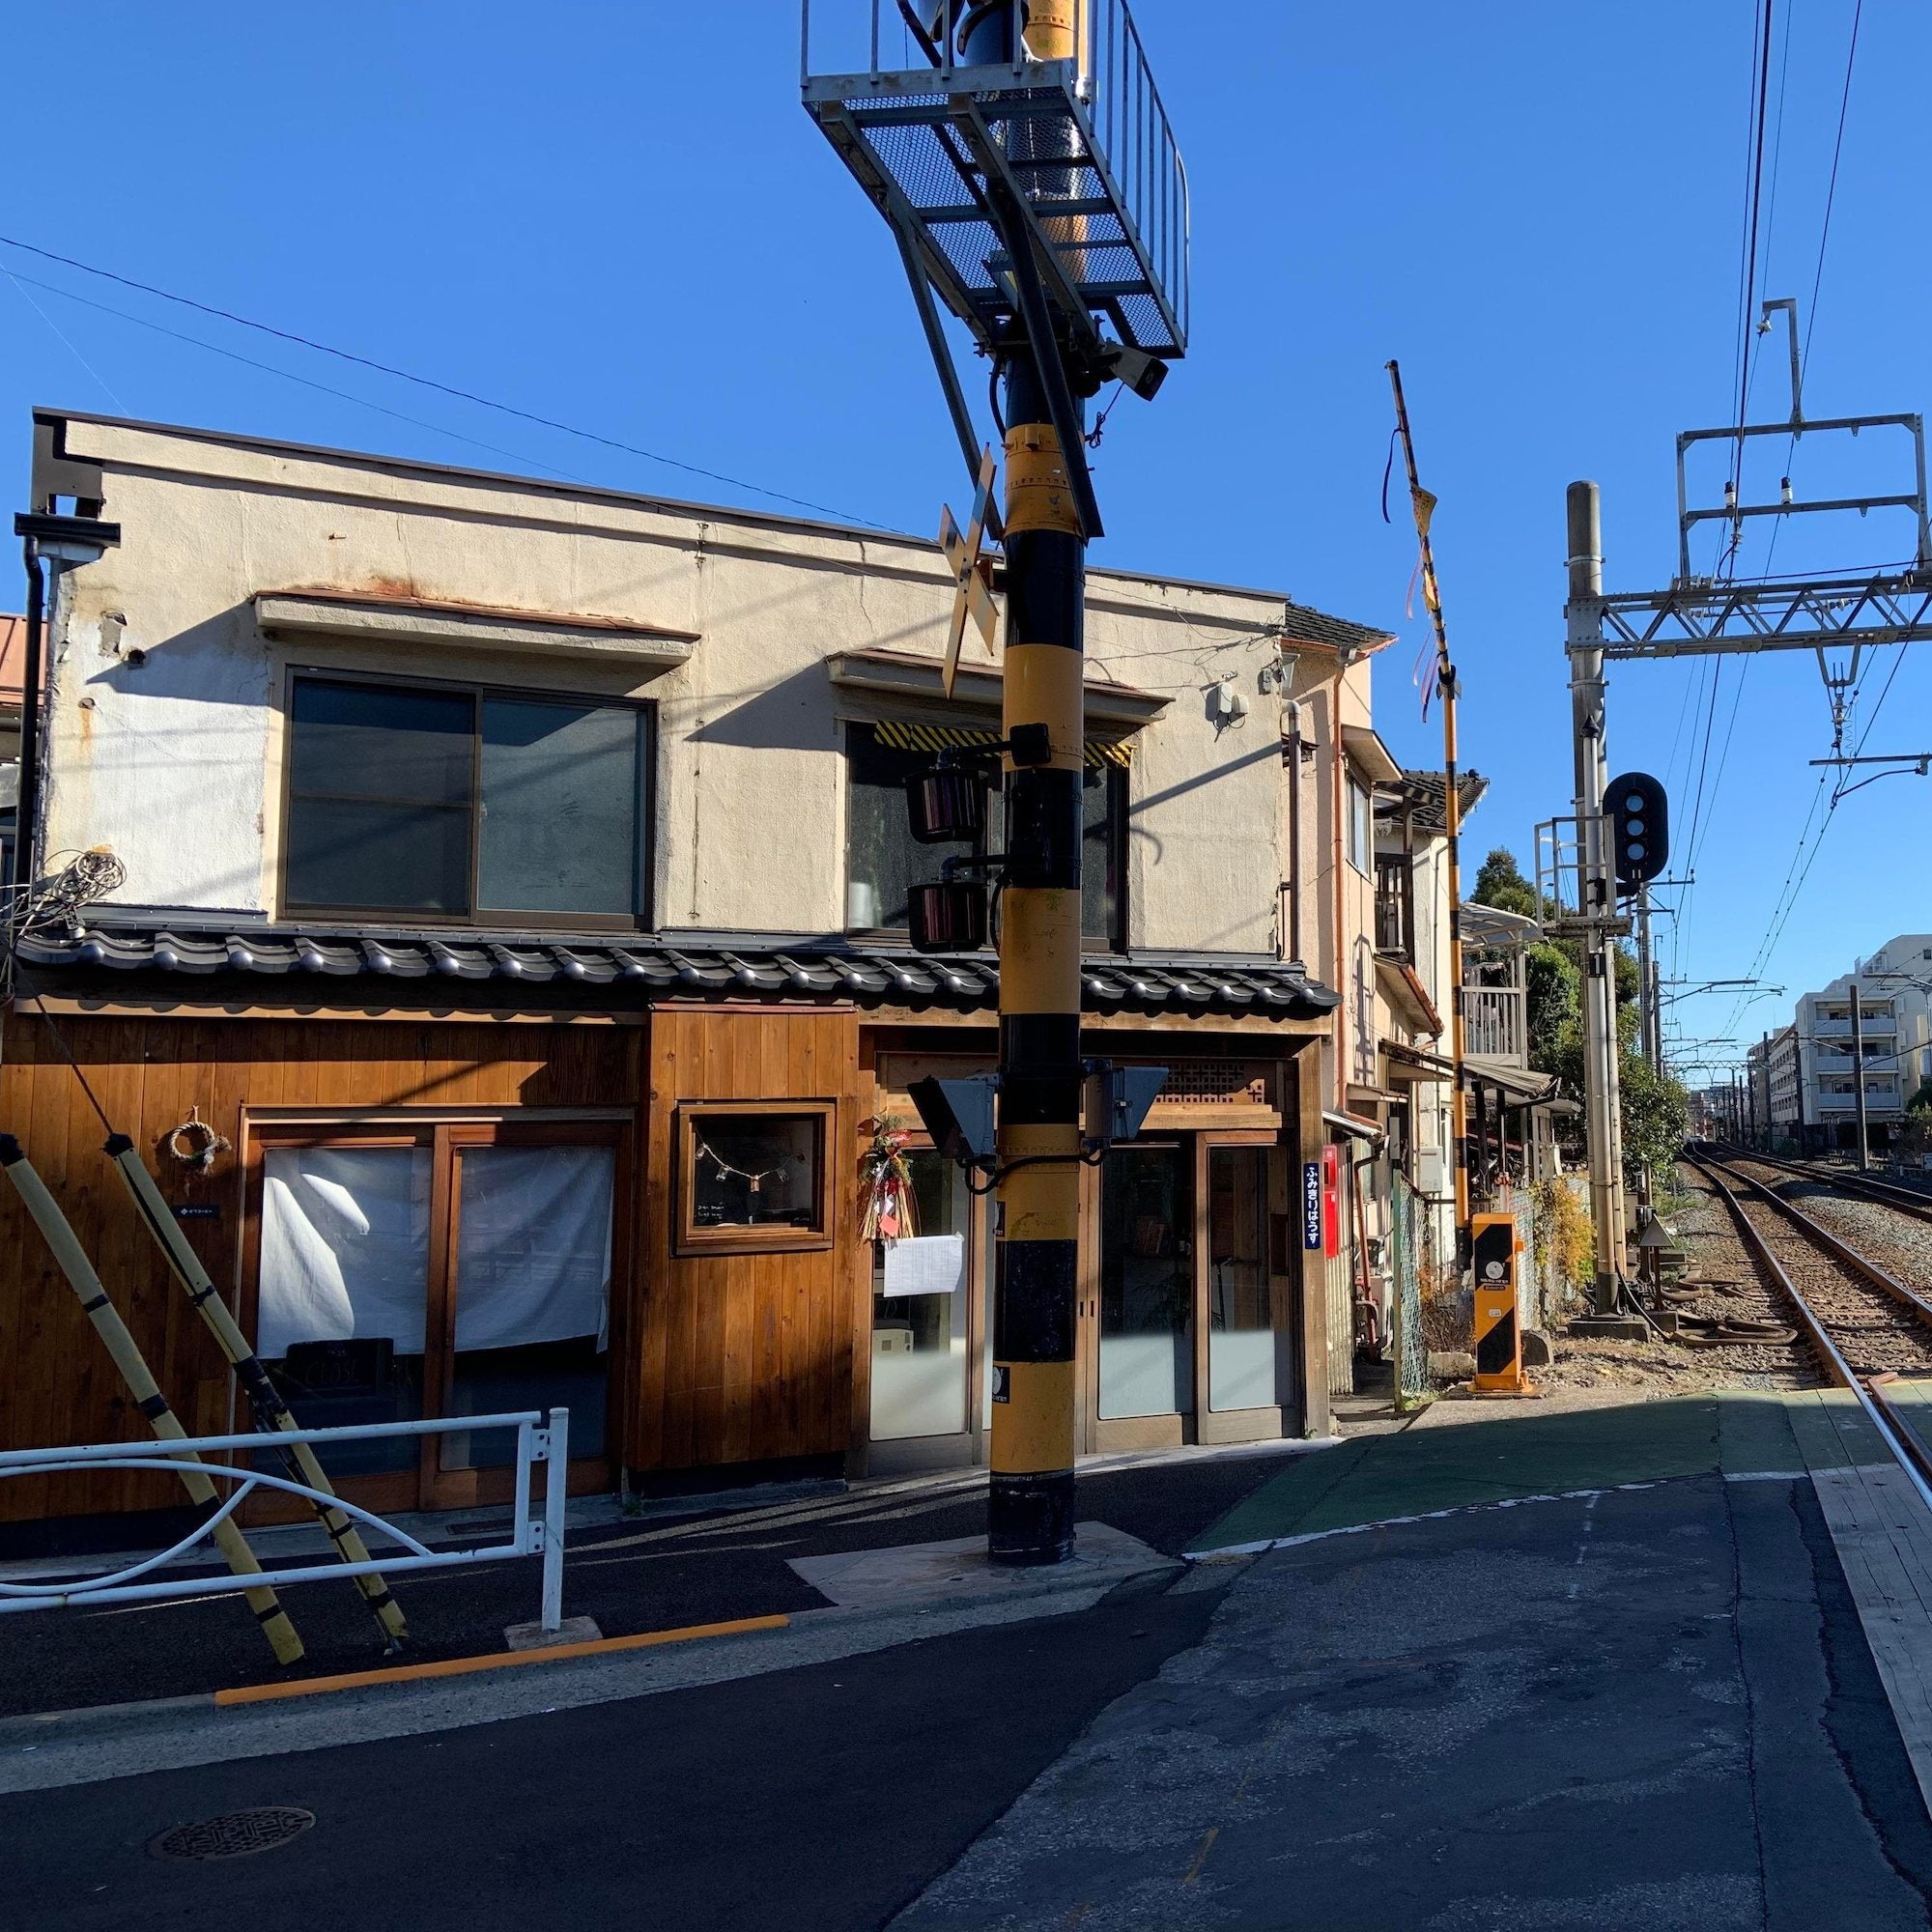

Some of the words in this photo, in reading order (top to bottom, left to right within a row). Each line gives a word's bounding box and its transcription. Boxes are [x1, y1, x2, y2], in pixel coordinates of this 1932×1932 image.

[1306, 1166, 1320, 1244] ふみきりはうす
